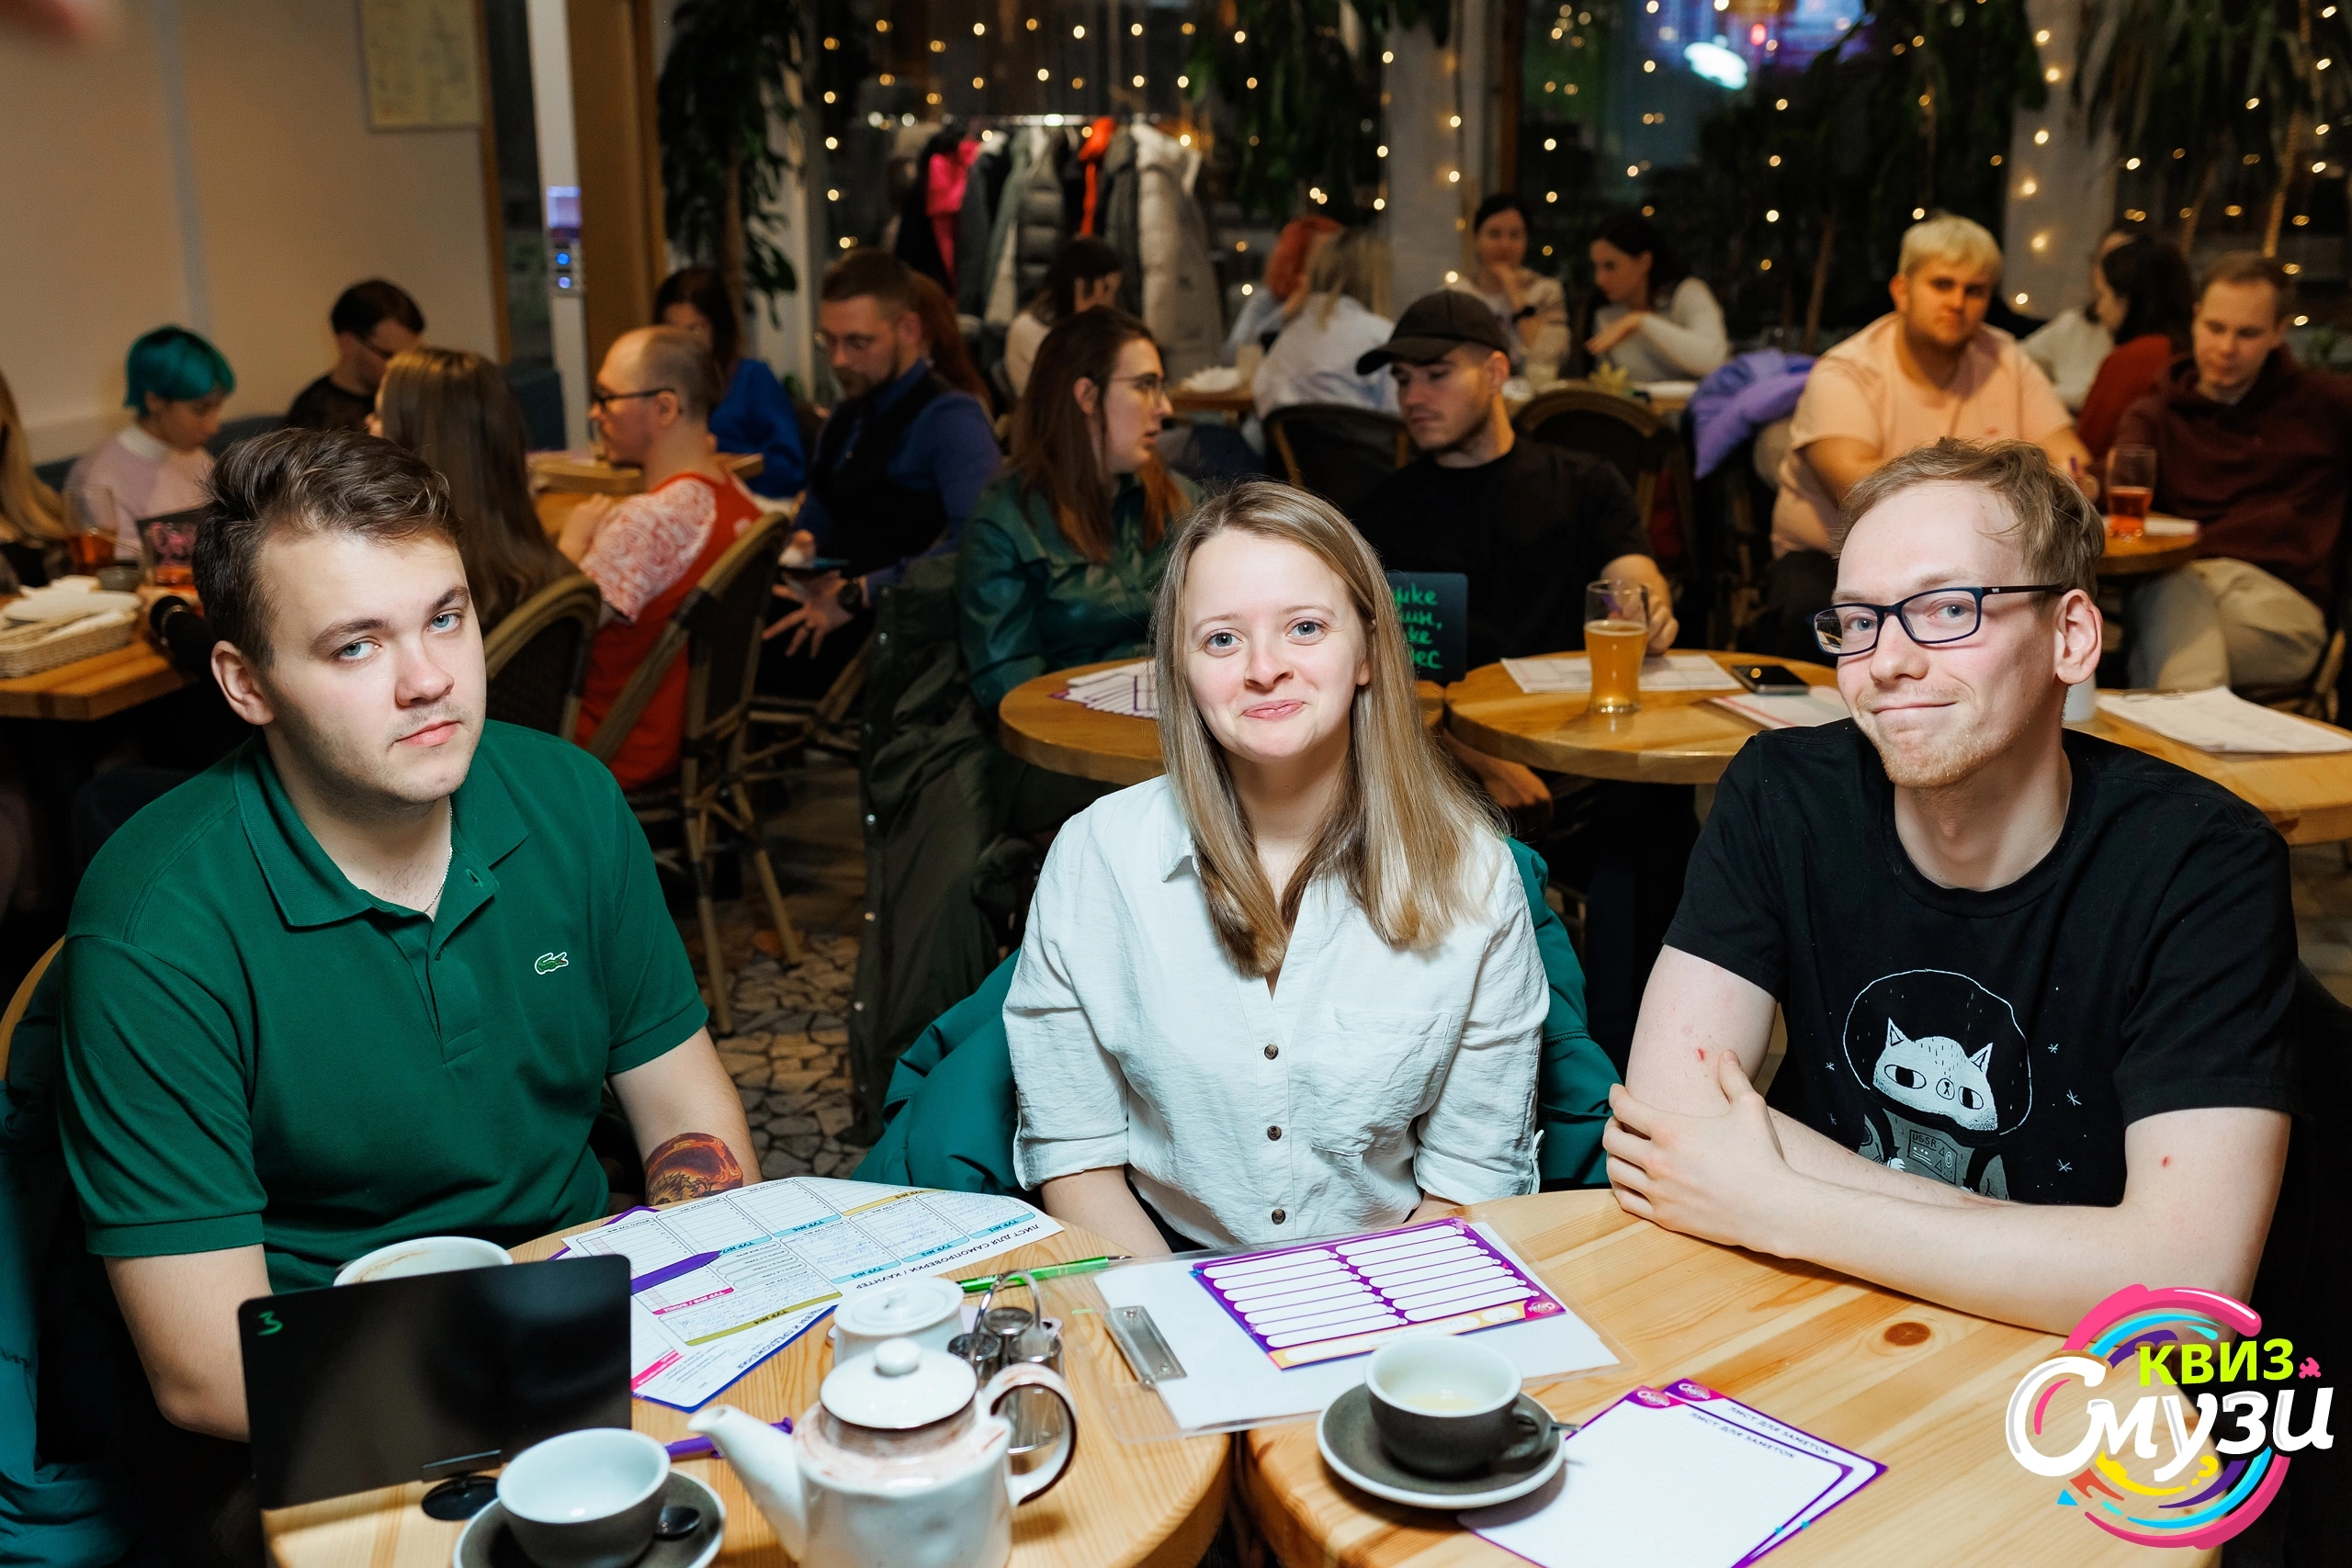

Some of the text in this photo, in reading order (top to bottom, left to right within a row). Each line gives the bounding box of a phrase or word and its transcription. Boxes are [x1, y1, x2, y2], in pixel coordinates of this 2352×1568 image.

[1912, 1133, 1938, 1149] USSR
[808, 1219, 824, 1227] ТУР
[988, 1219, 1018, 1233] ТУР №1
[1013, 1224, 1039, 1237] ЛИСТ
[990, 1234, 1011, 1246] ДЛЯ
[936, 1244, 953, 1252] ТУР
[909, 1243, 990, 1273] САМОПРОВЕРКИ
[855, 1272, 902, 1290] КАУНТЕР
[772, 1310, 789, 1319] ТУР
[256, 1310, 284, 1337] 3
